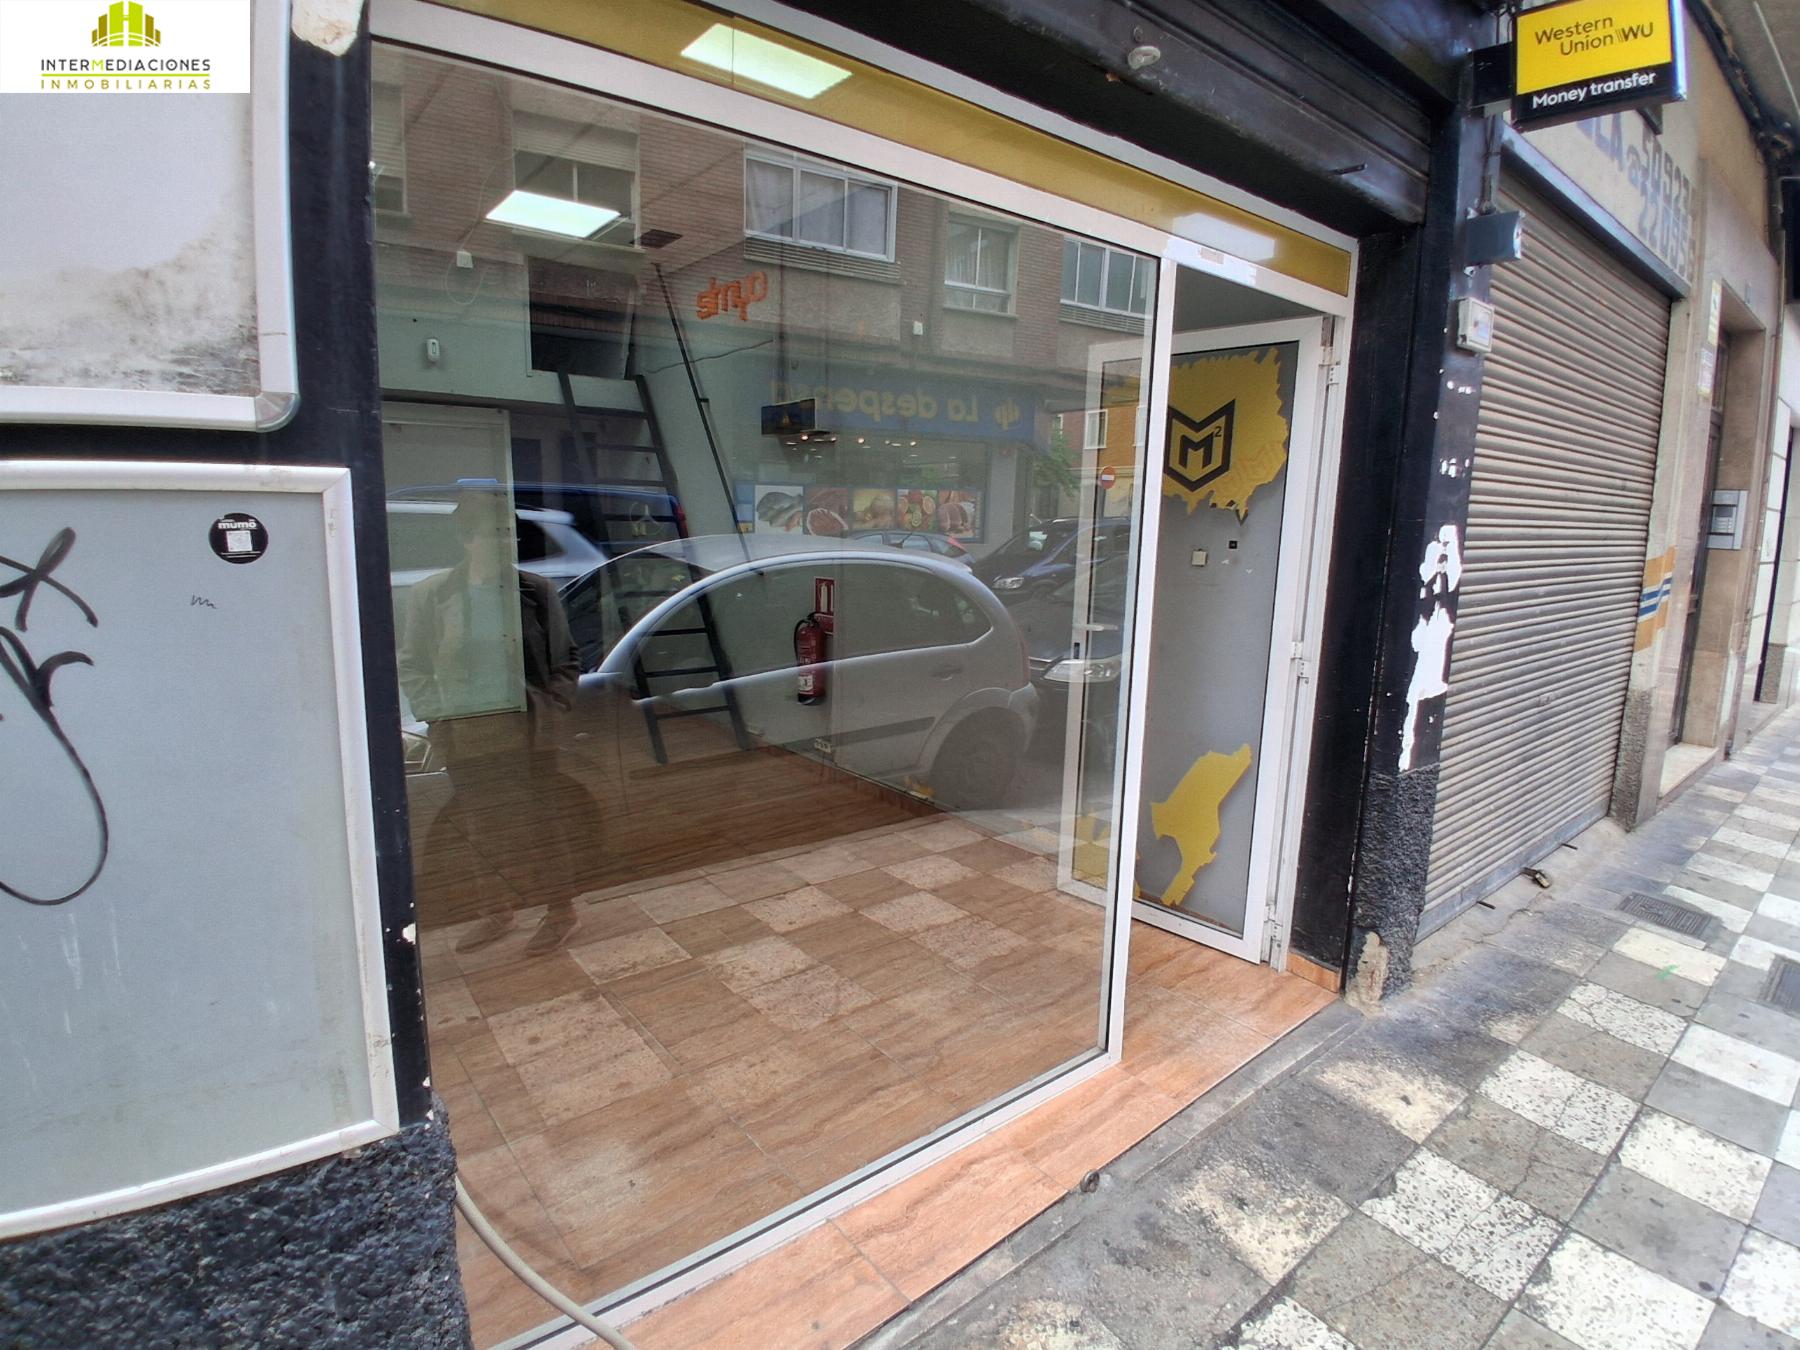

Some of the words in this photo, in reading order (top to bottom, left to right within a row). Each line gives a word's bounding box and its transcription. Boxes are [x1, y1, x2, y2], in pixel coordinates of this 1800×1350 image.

[1535, 17, 1613, 45] Western
[1560, 34, 1614, 56] Union
[1617, 22, 1654, 43] WU
[1532, 86, 1588, 109] Money
[1589, 72, 1657, 97] transfer
